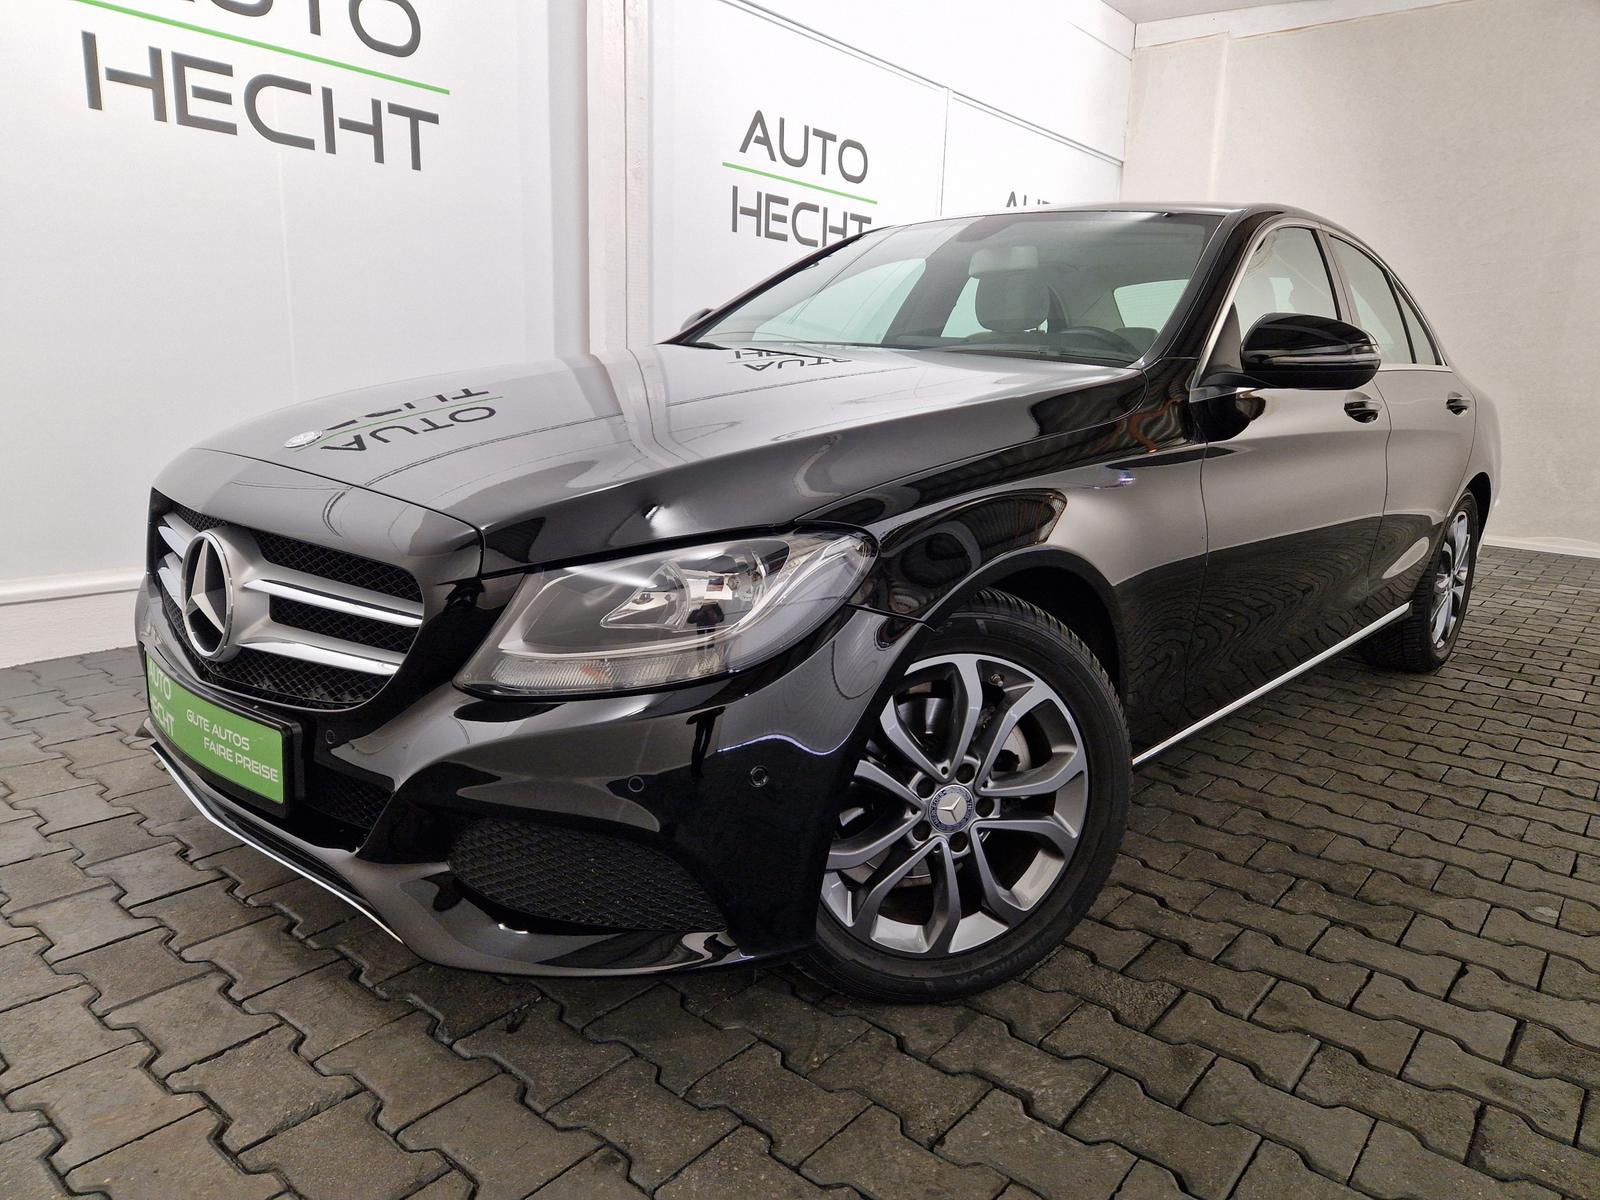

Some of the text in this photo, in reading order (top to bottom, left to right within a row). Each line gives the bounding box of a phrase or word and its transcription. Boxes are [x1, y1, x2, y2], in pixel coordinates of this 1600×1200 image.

[81, 30, 440, 171] HECHT
[739, 110, 869, 184] AUTO
[186, 709, 250, 751] GUTE AUTOS
[203, 737, 279, 783] FAIRE PREISE
